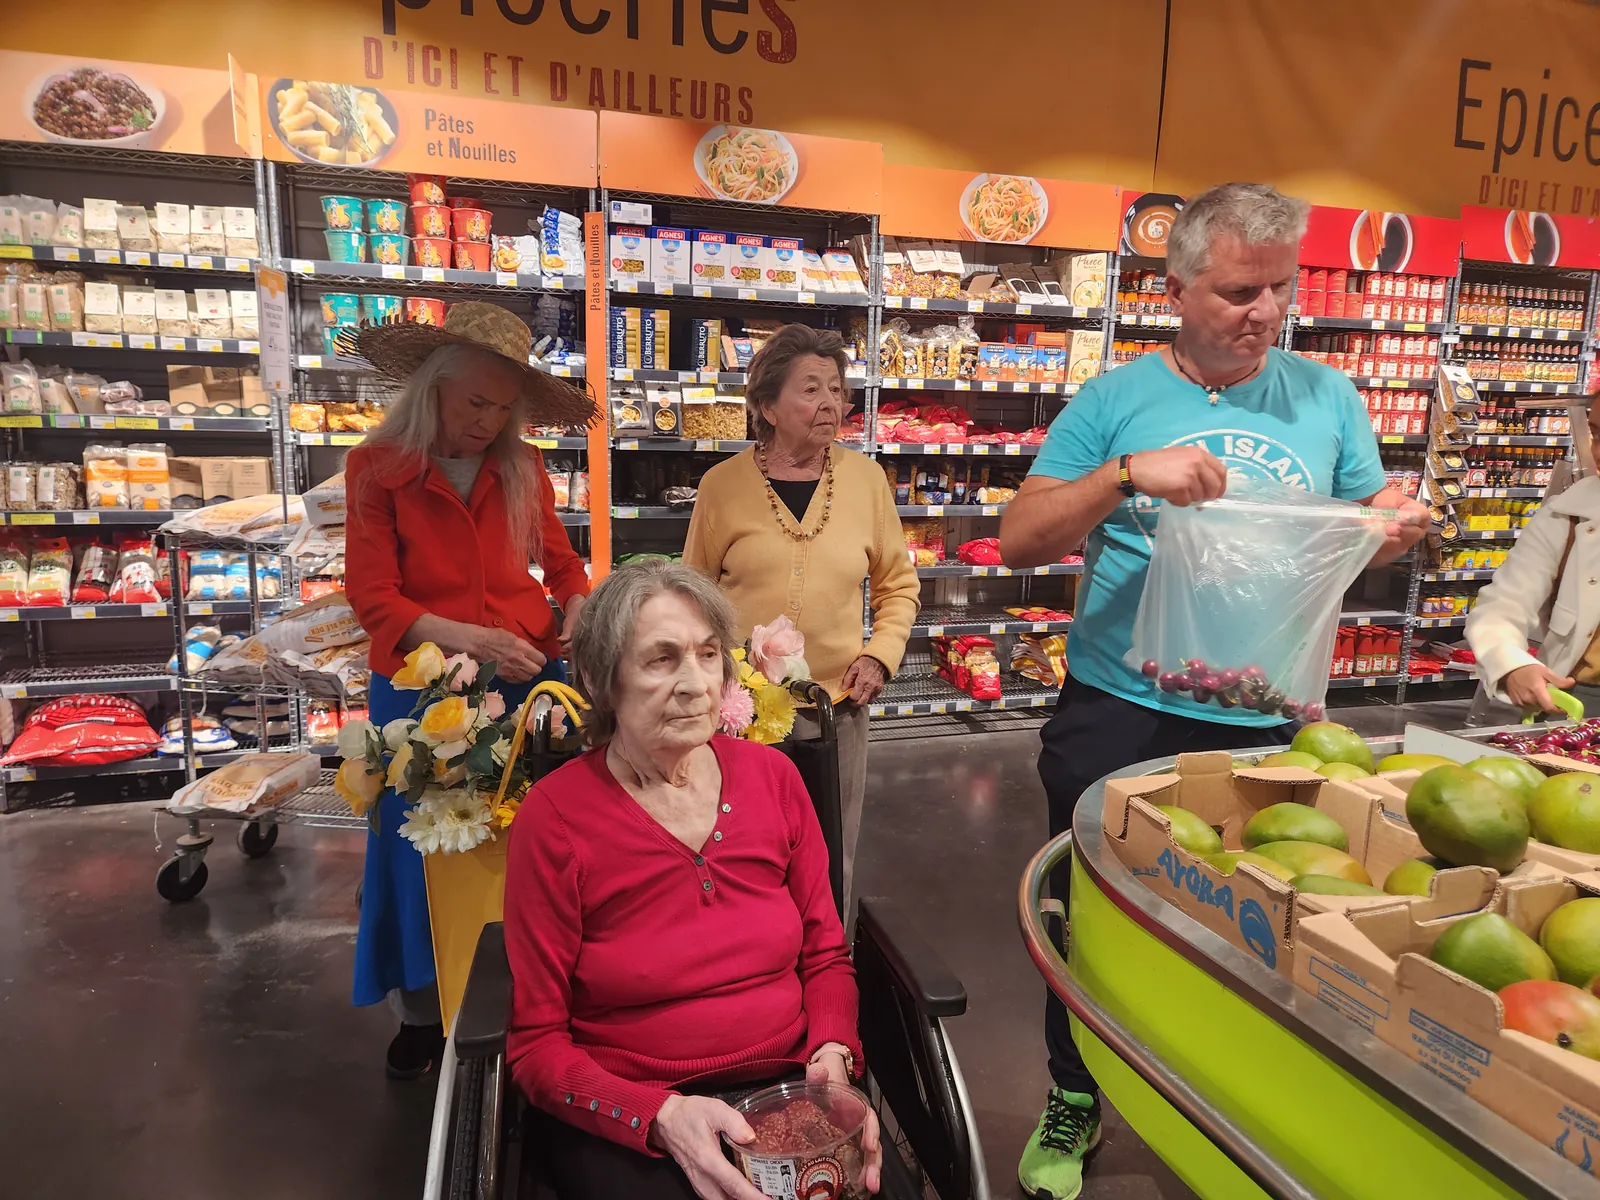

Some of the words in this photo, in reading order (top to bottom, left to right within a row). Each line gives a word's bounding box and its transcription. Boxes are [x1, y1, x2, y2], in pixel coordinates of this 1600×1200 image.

[363, 36, 458, 90] D'ICI
[484, 52, 524, 97] ET
[549, 61, 754, 125] D'AILLEURS
[424, 108, 474, 135] Pâtes
[427, 140, 444, 157] et
[447, 138, 517, 164] Nouilles
[1479, 175, 1529, 209] D'ICI
[1537, 182, 1562, 212] ET
[590, 224, 601, 265] Nouilles
[618, 228, 644, 236] AGNESI
[659, 231, 683, 239] AGNESI
[700, 235, 725, 243] AGNESI
[738, 238, 761, 246] AGNESI
[773, 241, 797, 249] AGNESI
[593, 268, 600, 279] et
[589, 282, 601, 311] Pâtes
[616, 317, 625, 354] BERRUTO
[644, 319, 654, 355] BERRUTO
[1223, 435, 1307, 491] ISLAN
